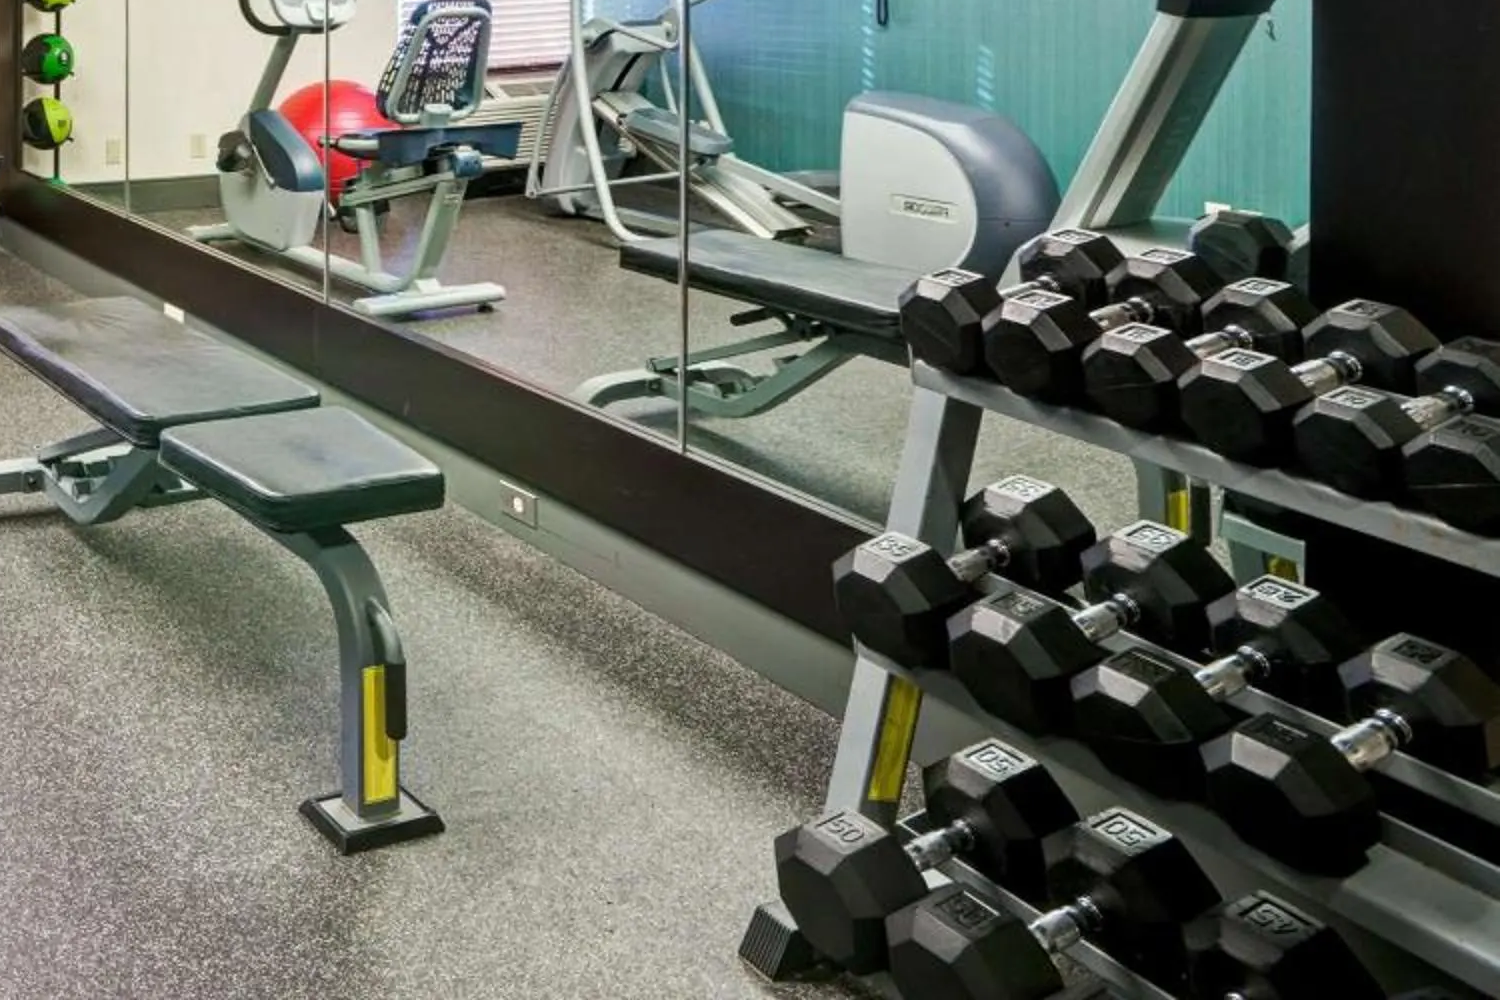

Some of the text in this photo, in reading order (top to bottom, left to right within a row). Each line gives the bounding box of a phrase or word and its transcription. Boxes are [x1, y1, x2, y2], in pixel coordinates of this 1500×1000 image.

[977, 749, 1016, 774] 50
[826, 818, 866, 844] 50
[1103, 820, 1147, 848] 50
